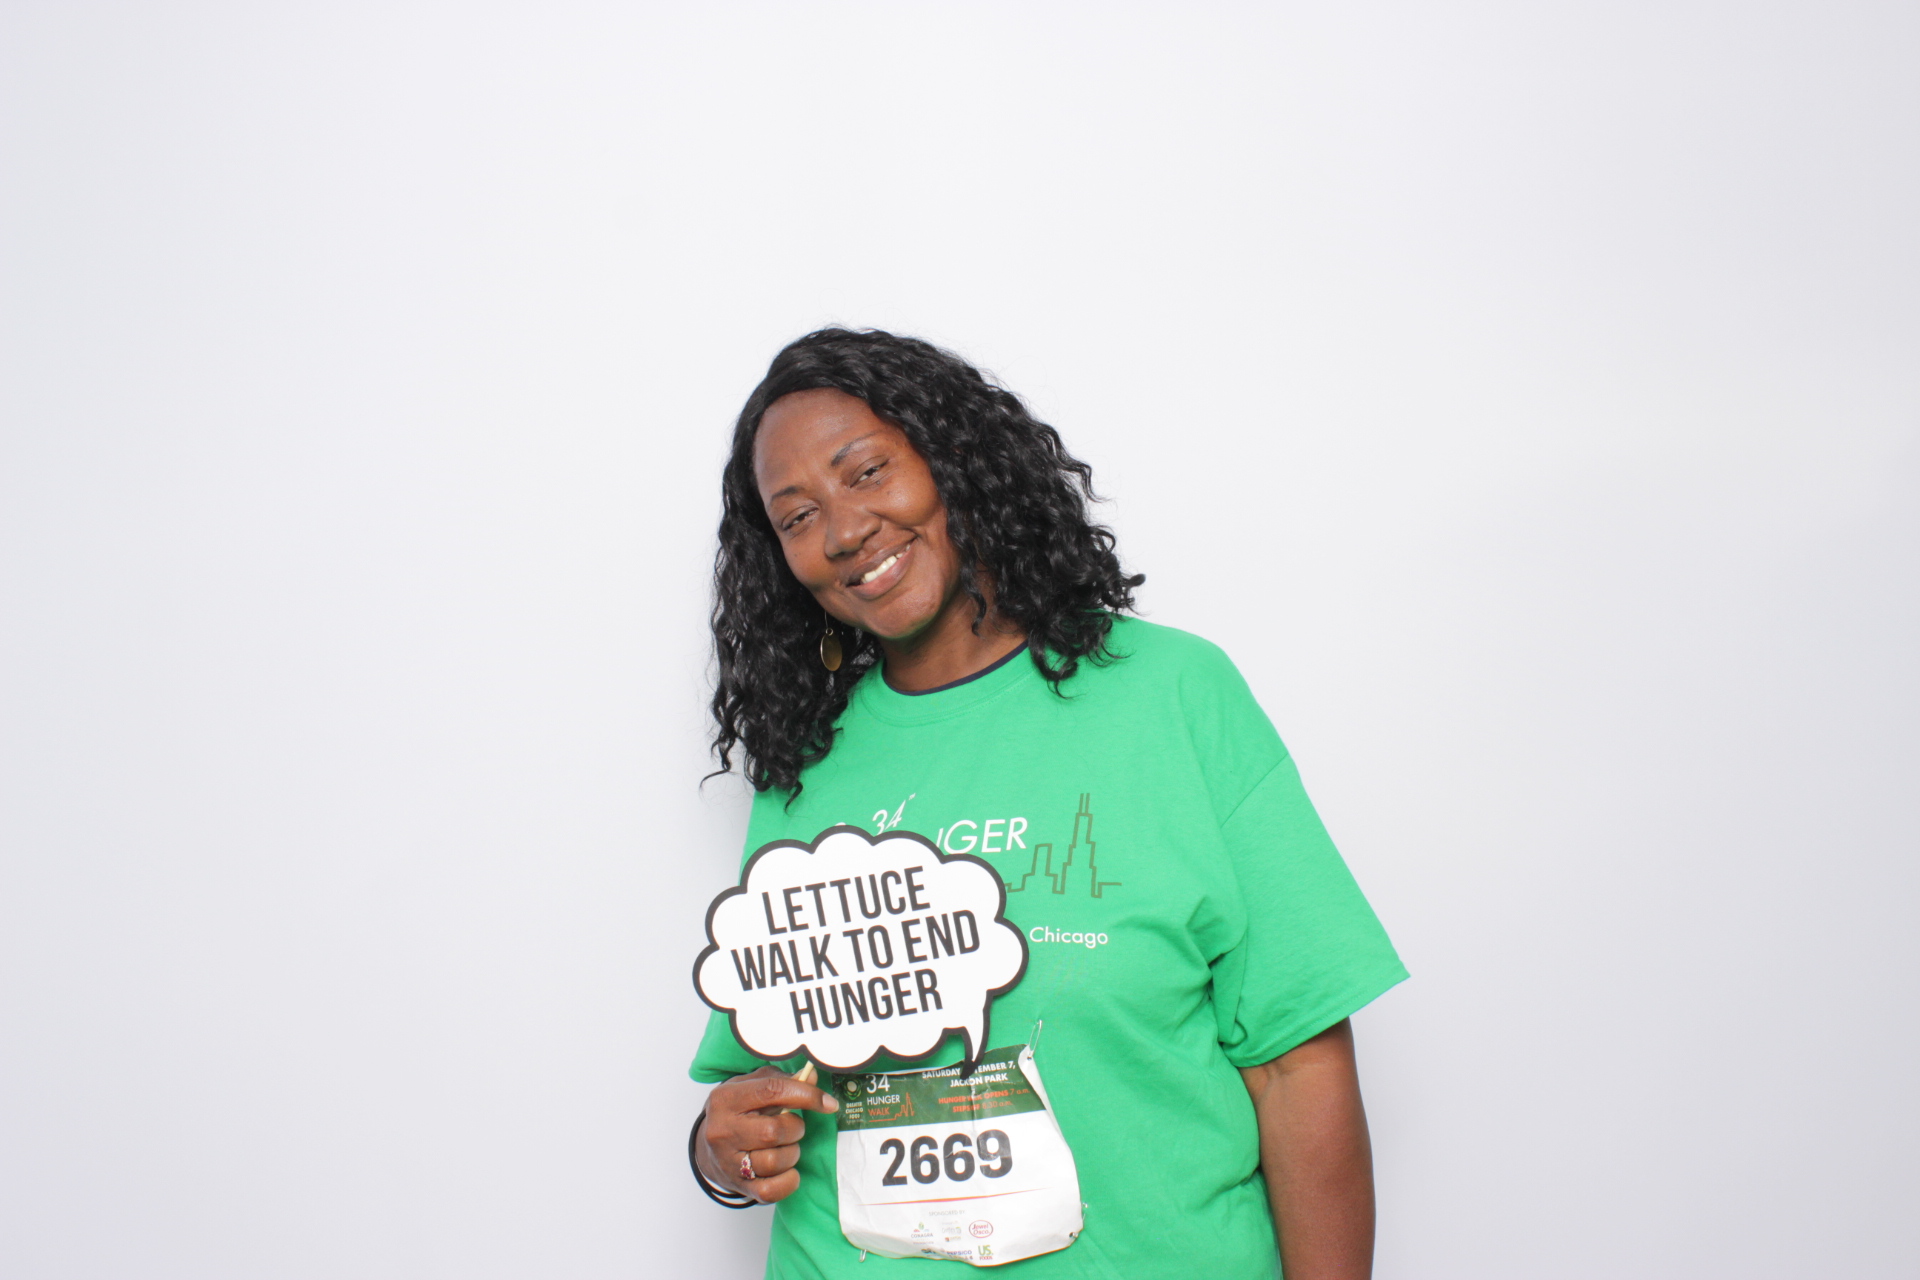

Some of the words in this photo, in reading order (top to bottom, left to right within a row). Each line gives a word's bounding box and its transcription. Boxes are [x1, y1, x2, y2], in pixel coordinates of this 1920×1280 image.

[872, 799, 906, 835] 34
[762, 866, 931, 935] LETTUCE
[1029, 926, 1108, 949] Chicago
[731, 933, 839, 991] WALK
[842, 925, 894, 973] TO
[901, 909, 980, 964] END
[789, 968, 943, 1034] HUNGER
[922, 1068, 961, 1079] SATURDAY
[1008, 1060, 1016, 1070] 7,
[985, 1073, 1009, 1084] PARK
[866, 1074, 890, 1094] 34
[983, 1089, 1009, 1100] OPENS
[867, 1094, 900, 1106] HUNGER
[868, 1107, 890, 1116] WALK
[880, 1128, 1013, 1187] 2669
